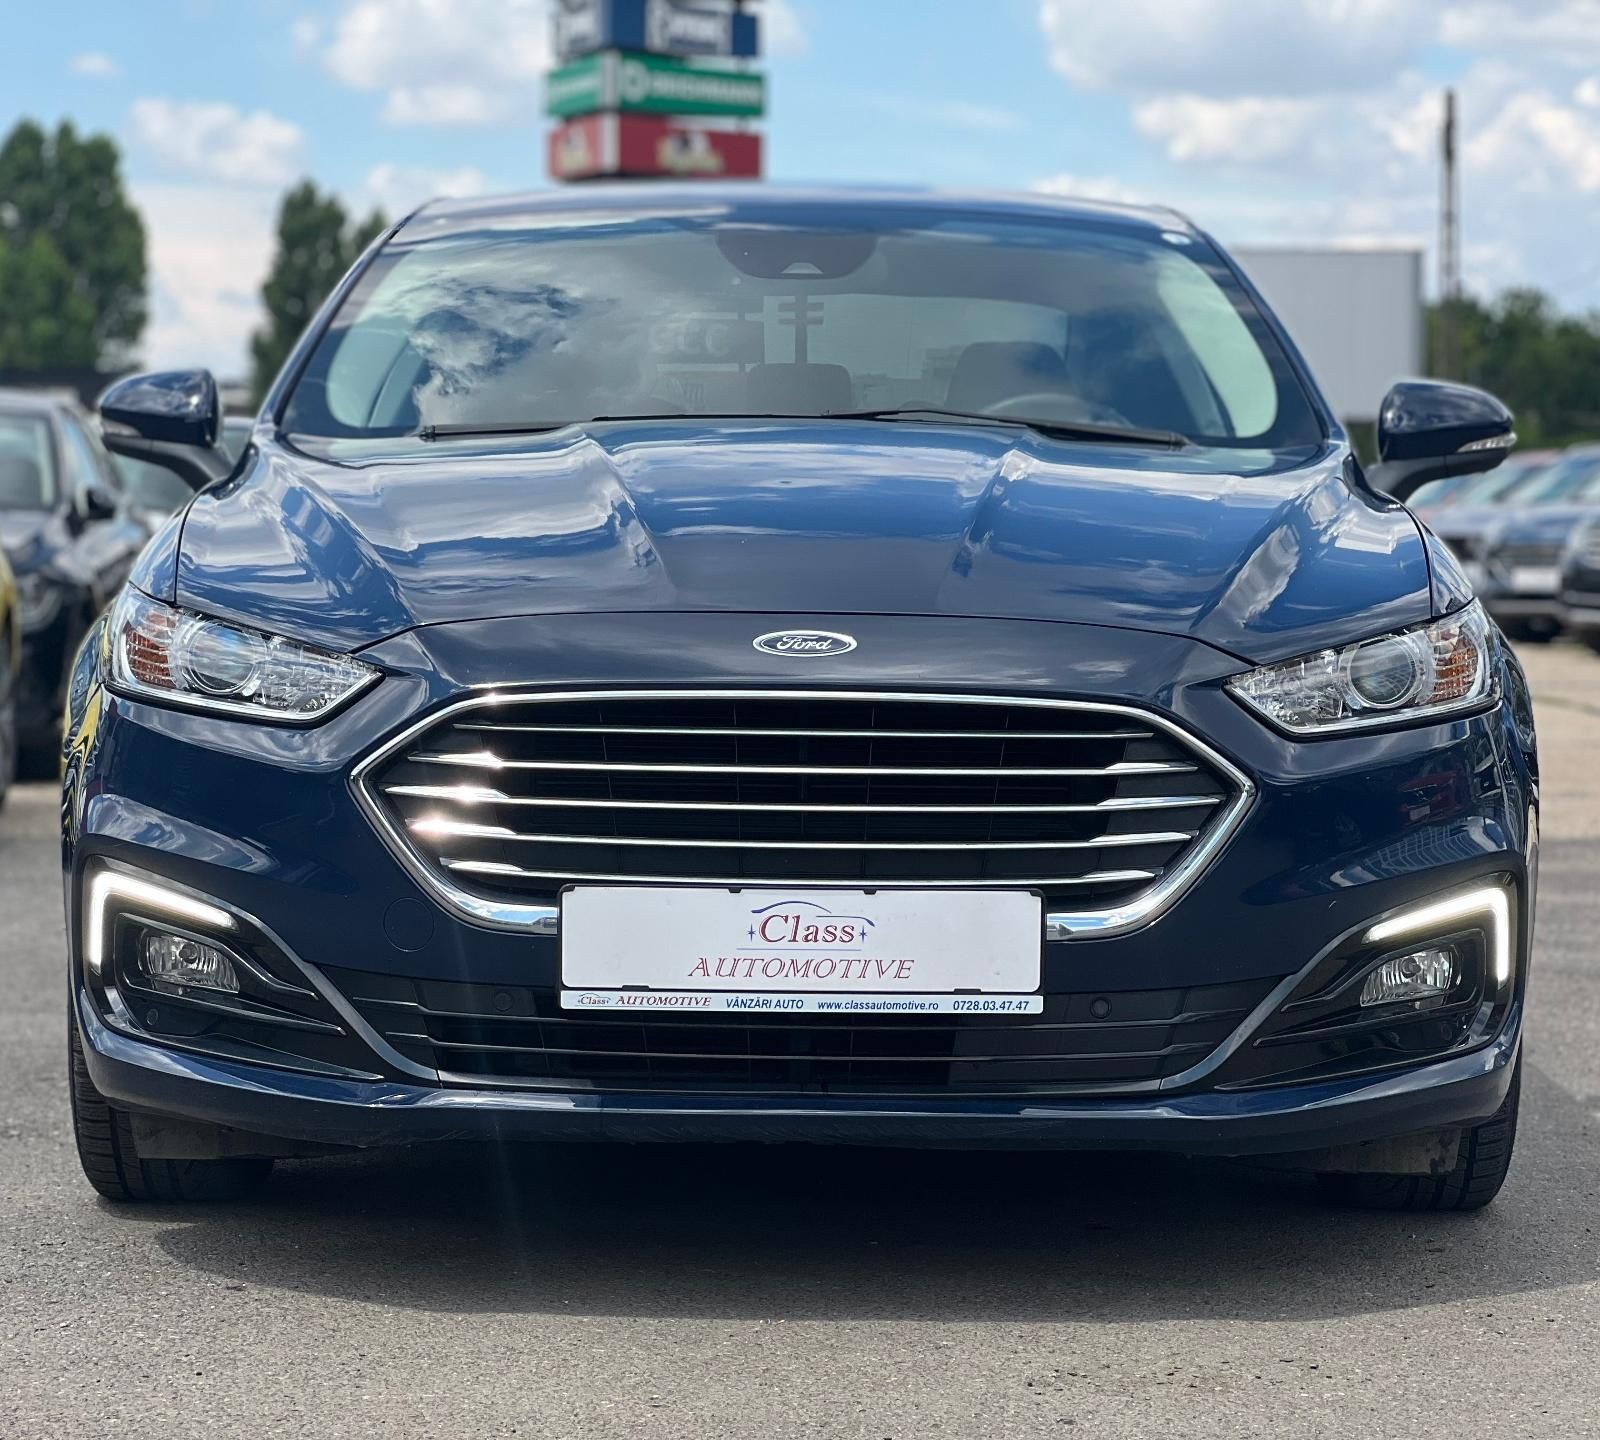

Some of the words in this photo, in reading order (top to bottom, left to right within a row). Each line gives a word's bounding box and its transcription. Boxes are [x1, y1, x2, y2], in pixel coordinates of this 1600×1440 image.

[777, 635, 833, 650] Ford
[758, 914, 855, 943] Class
[687, 957, 915, 979] AUTOMOTIVE
[580, 996, 606, 1005] Class
[616, 996, 712, 1007] AUTOMOTIVE
[774, 999, 804, 1009] AUTO
[818, 1000, 939, 1011] www.classautomotive.ro
[953, 1000, 1029, 1011] 0728.03.47.47
